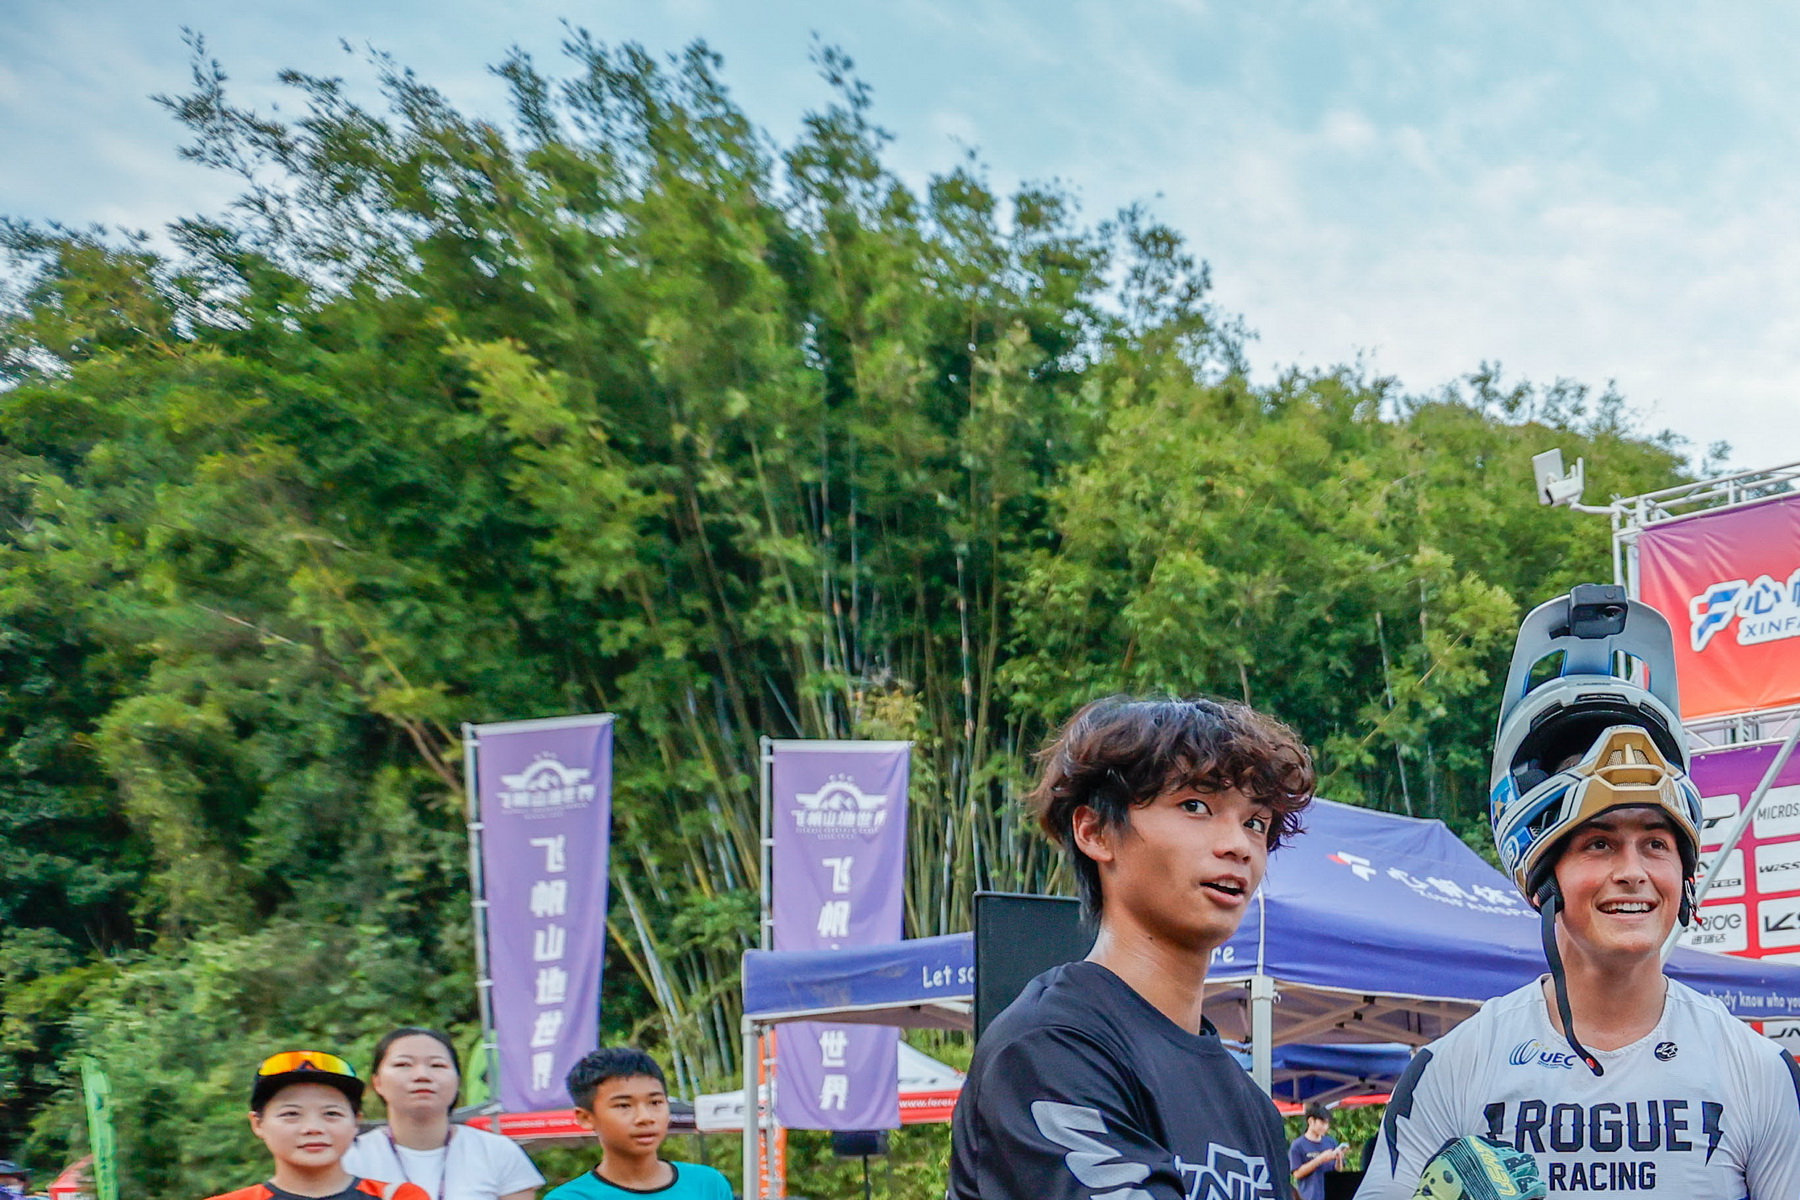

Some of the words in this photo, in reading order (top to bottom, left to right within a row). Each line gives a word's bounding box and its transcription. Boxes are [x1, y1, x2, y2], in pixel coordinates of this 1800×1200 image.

[529, 833, 569, 1093] 飞帆山地世界
[922, 965, 953, 989] Let
[817, 855, 855, 1112] 飞帆世界
[1738, 990, 1764, 1007] know
[1767, 991, 1786, 1007] who
[1540, 1052, 1577, 1067] UEC
[1514, 1099, 1693, 1153] ROGUE
[1548, 1162, 1657, 1191] RACING
